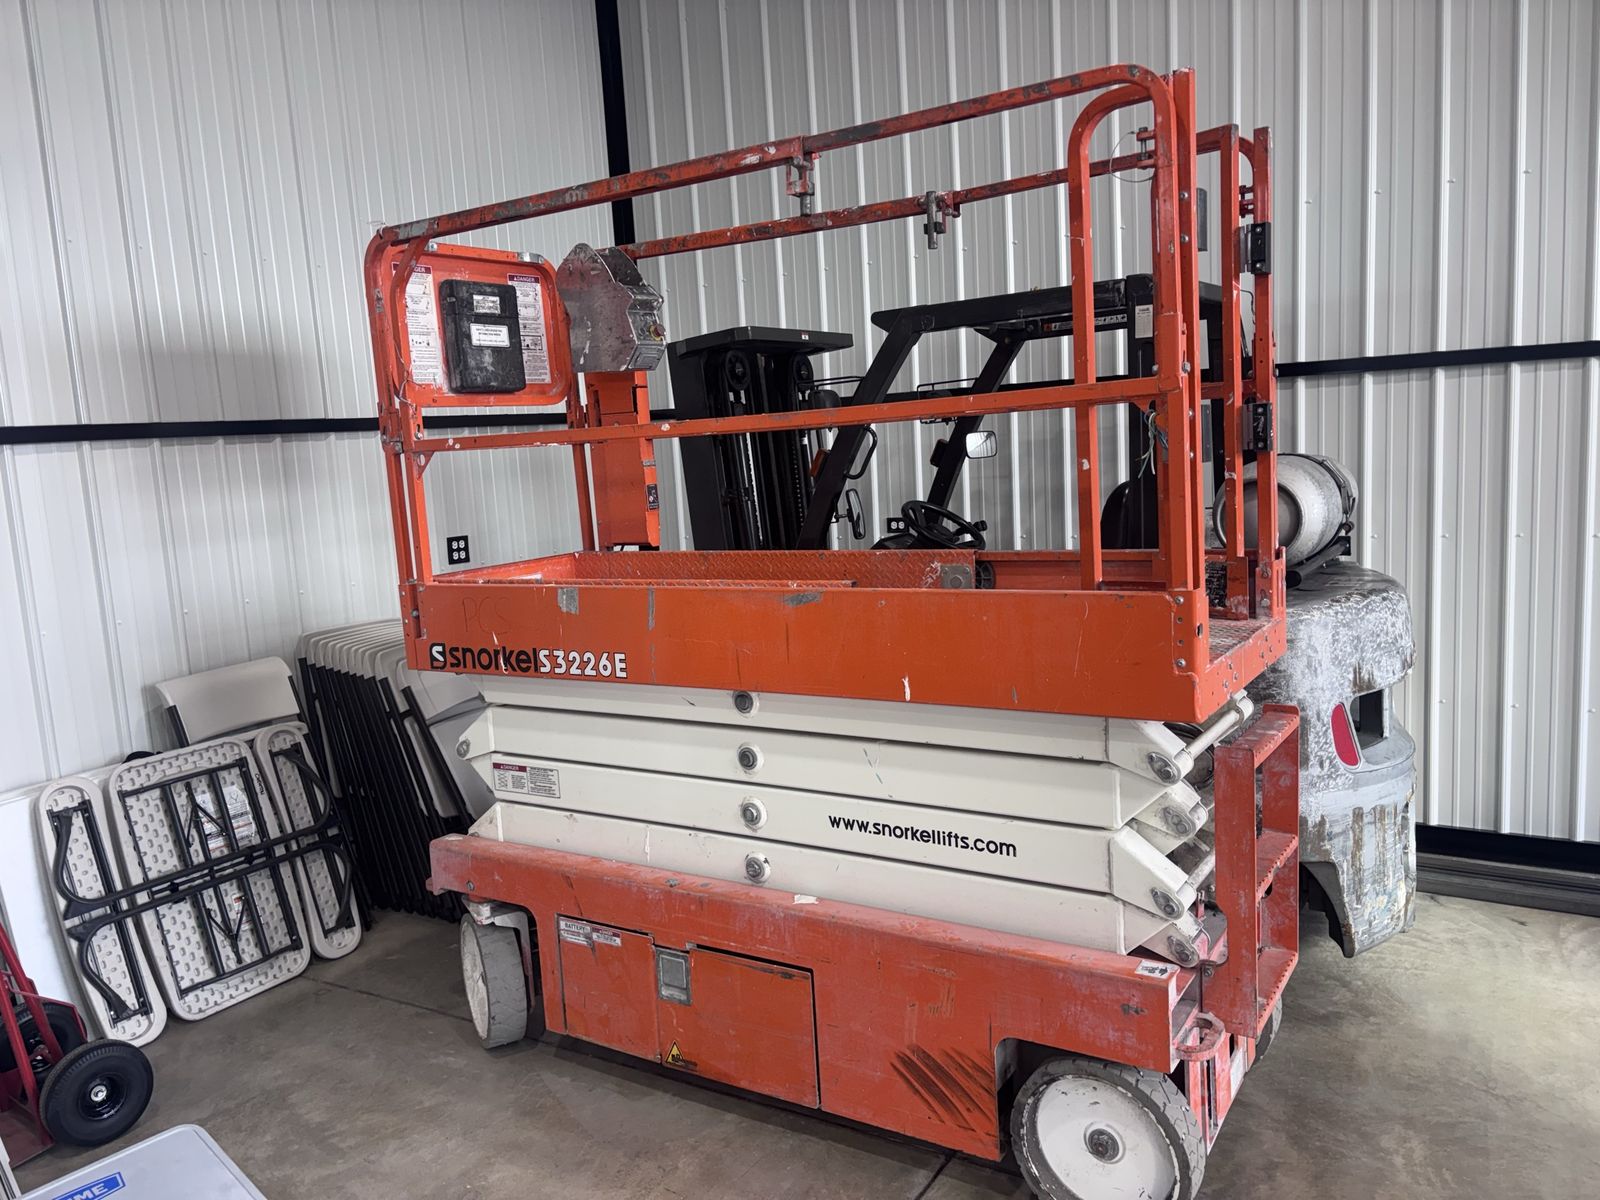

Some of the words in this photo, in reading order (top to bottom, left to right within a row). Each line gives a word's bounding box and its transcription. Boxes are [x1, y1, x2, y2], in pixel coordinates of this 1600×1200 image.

[449, 645, 538, 673] snorkel
[538, 649, 627, 679] S3226E
[828, 815, 1017, 857] www.snorkellifts.com
